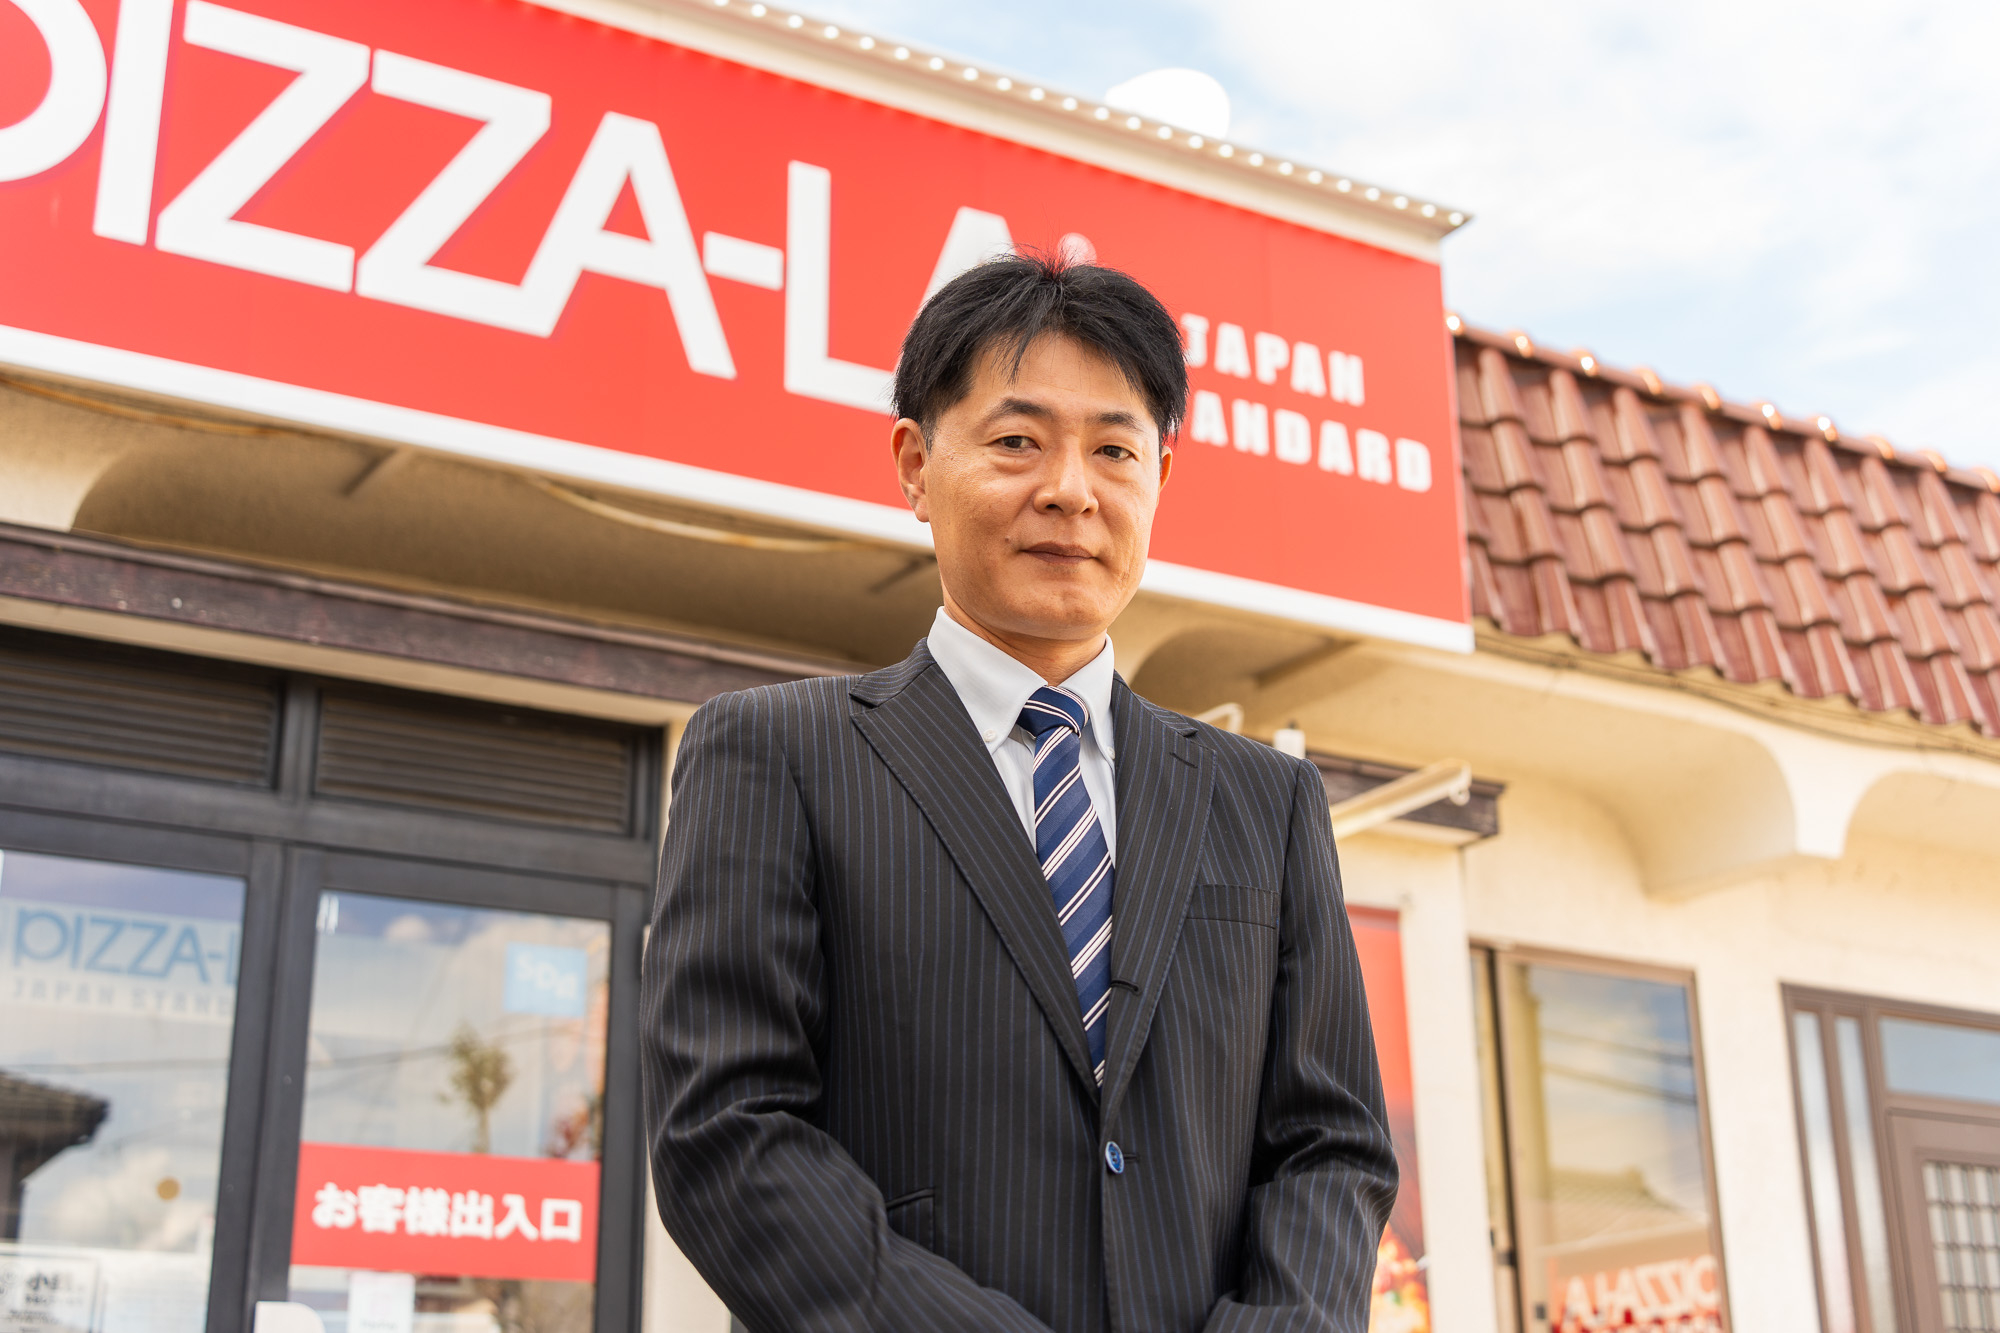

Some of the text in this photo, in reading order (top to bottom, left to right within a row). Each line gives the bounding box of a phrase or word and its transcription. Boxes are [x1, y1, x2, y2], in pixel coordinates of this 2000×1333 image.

[1180, 311, 1366, 408] JAPAN
[1168, 388, 1433, 494] ANDARD
[12, 975, 116, 1005] JAPAN
[311, 1181, 583, 1243] お客様出入口
